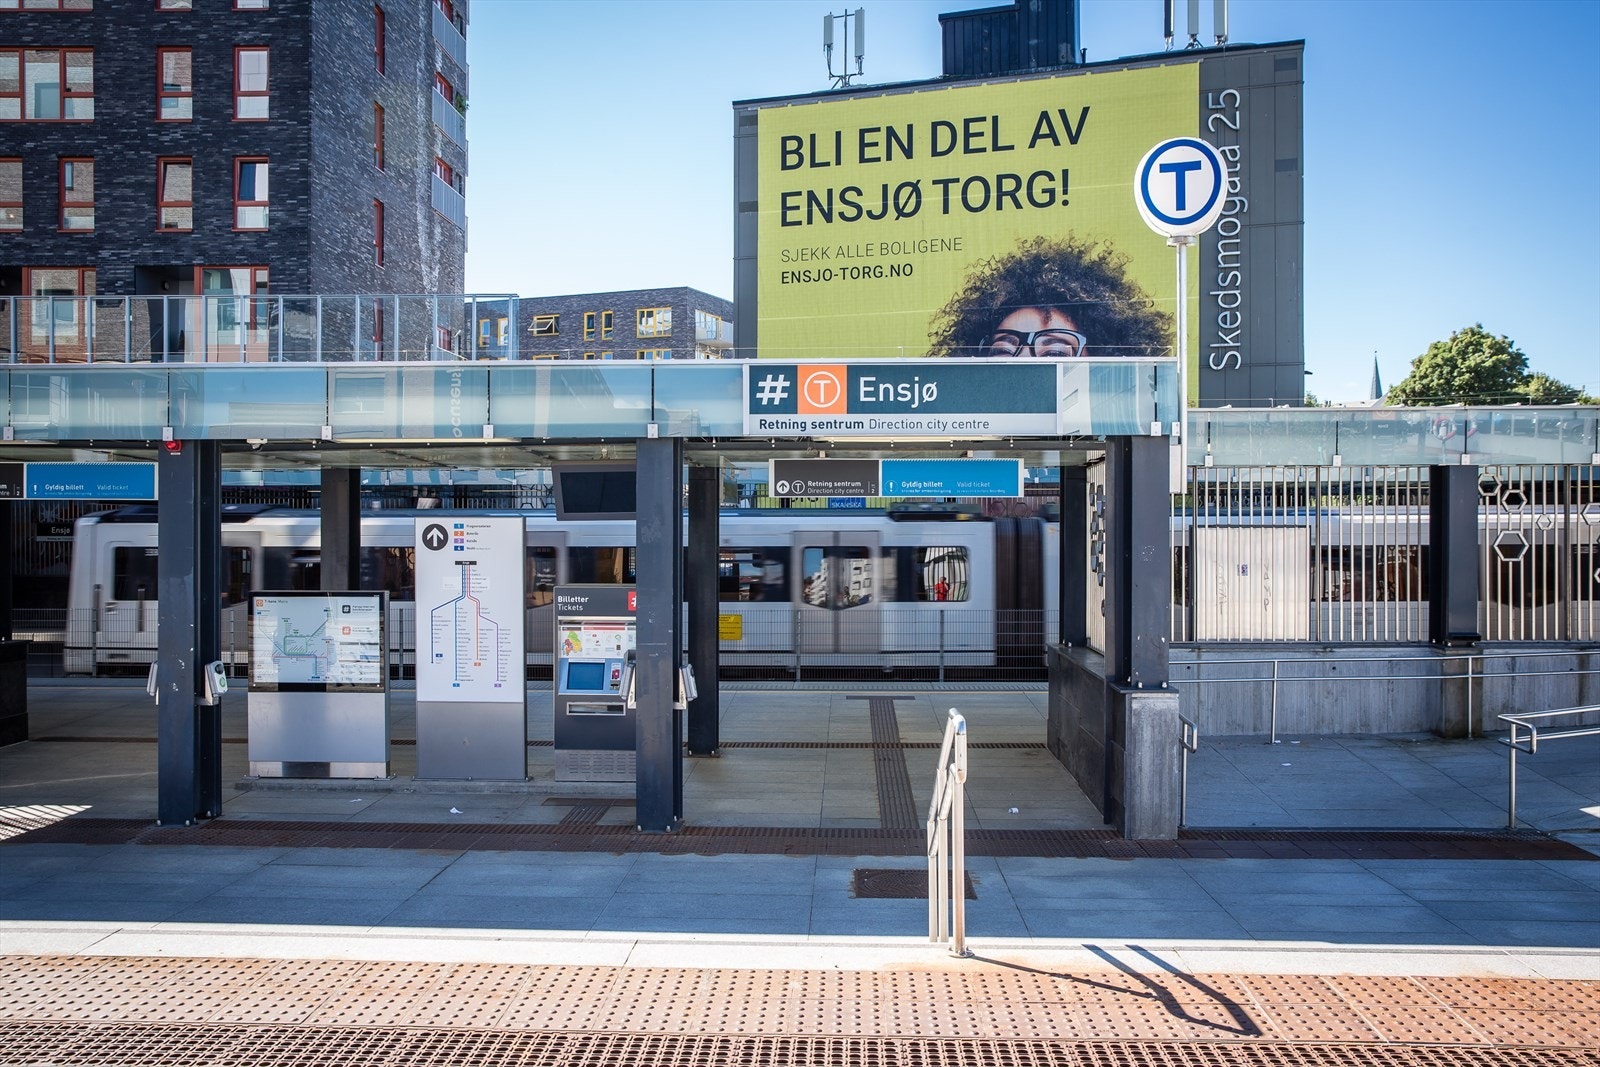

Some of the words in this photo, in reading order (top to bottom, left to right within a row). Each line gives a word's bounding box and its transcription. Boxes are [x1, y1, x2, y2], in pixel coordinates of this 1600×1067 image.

[1207, 88, 1241, 132] 25
[780, 130, 841, 171] BLI
[858, 123, 914, 164] EN
[931, 115, 1015, 158] DEL
[1028, 106, 1091, 150] AV
[780, 178, 923, 228] ENSJØ
[931, 168, 1070, 214] TORG!
[781, 246, 831, 263] SJEKK
[836, 242, 875, 259] ALLE
[880, 236, 963, 256] BOLIGENE
[781, 263, 914, 285] ENSJO-TORG.NO
[859, 376, 938, 408] Ensjø
[759, 418, 807, 432] Retning
[810, 419, 865, 430] sentrum
[869, 418, 923, 430] Direction
[926, 418, 948, 432] city
[951, 419, 990, 430] centre
[44, 484, 65, 492] Gyldig
[807, 480, 833, 489] Retning
[834, 487, 845, 495] city
[901, 481, 923, 489] Gyldig
[557, 595, 589, 605] Billetter
[557, 603, 584, 611] Tickets
